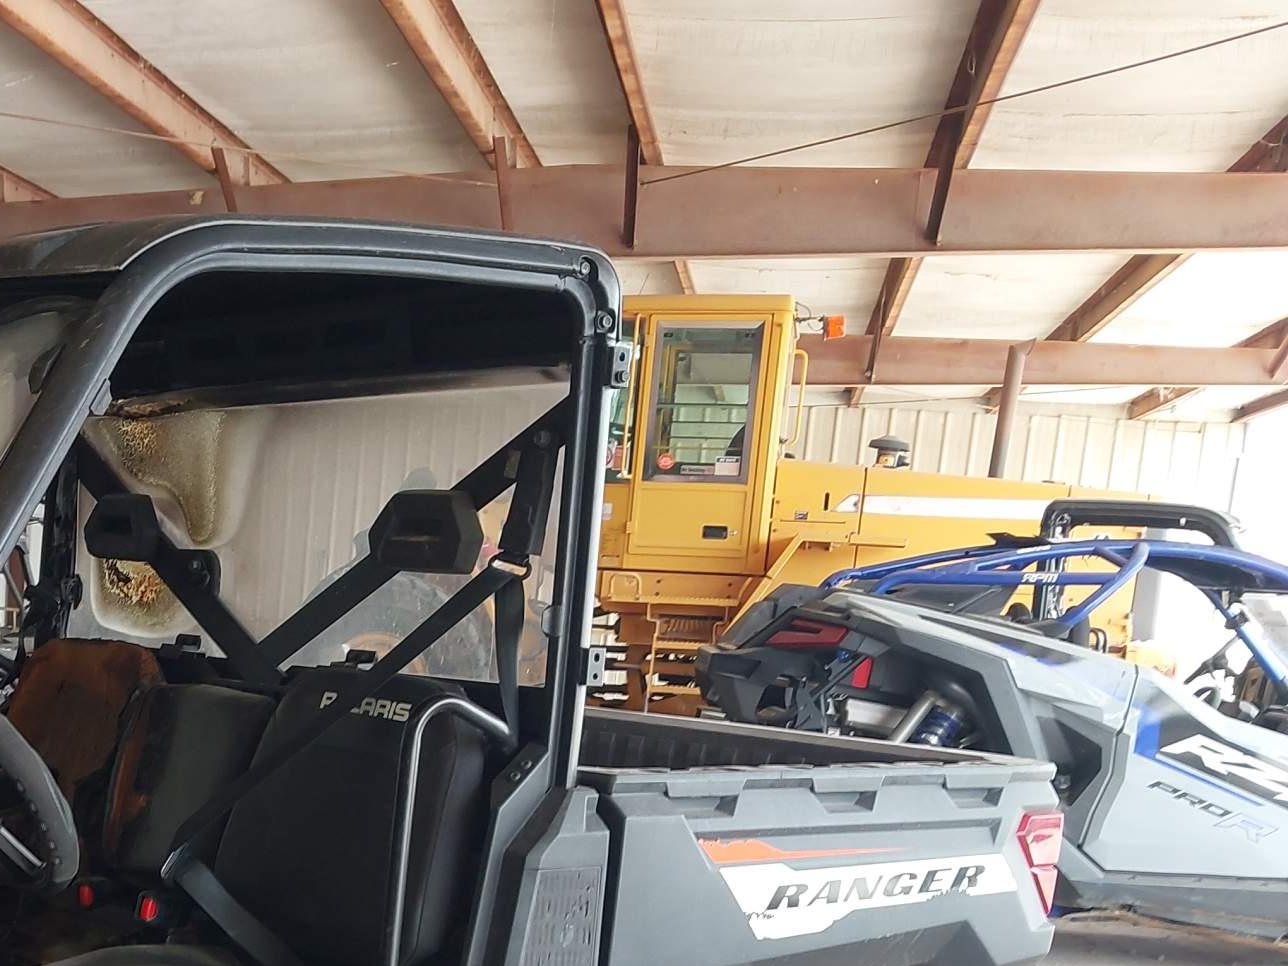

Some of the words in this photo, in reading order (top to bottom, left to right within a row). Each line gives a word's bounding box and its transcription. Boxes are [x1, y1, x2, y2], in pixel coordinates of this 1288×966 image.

[319, 691, 412, 722] PARIS
[1145, 780, 1233, 818] PRO
[765, 864, 987, 911] RANGER
